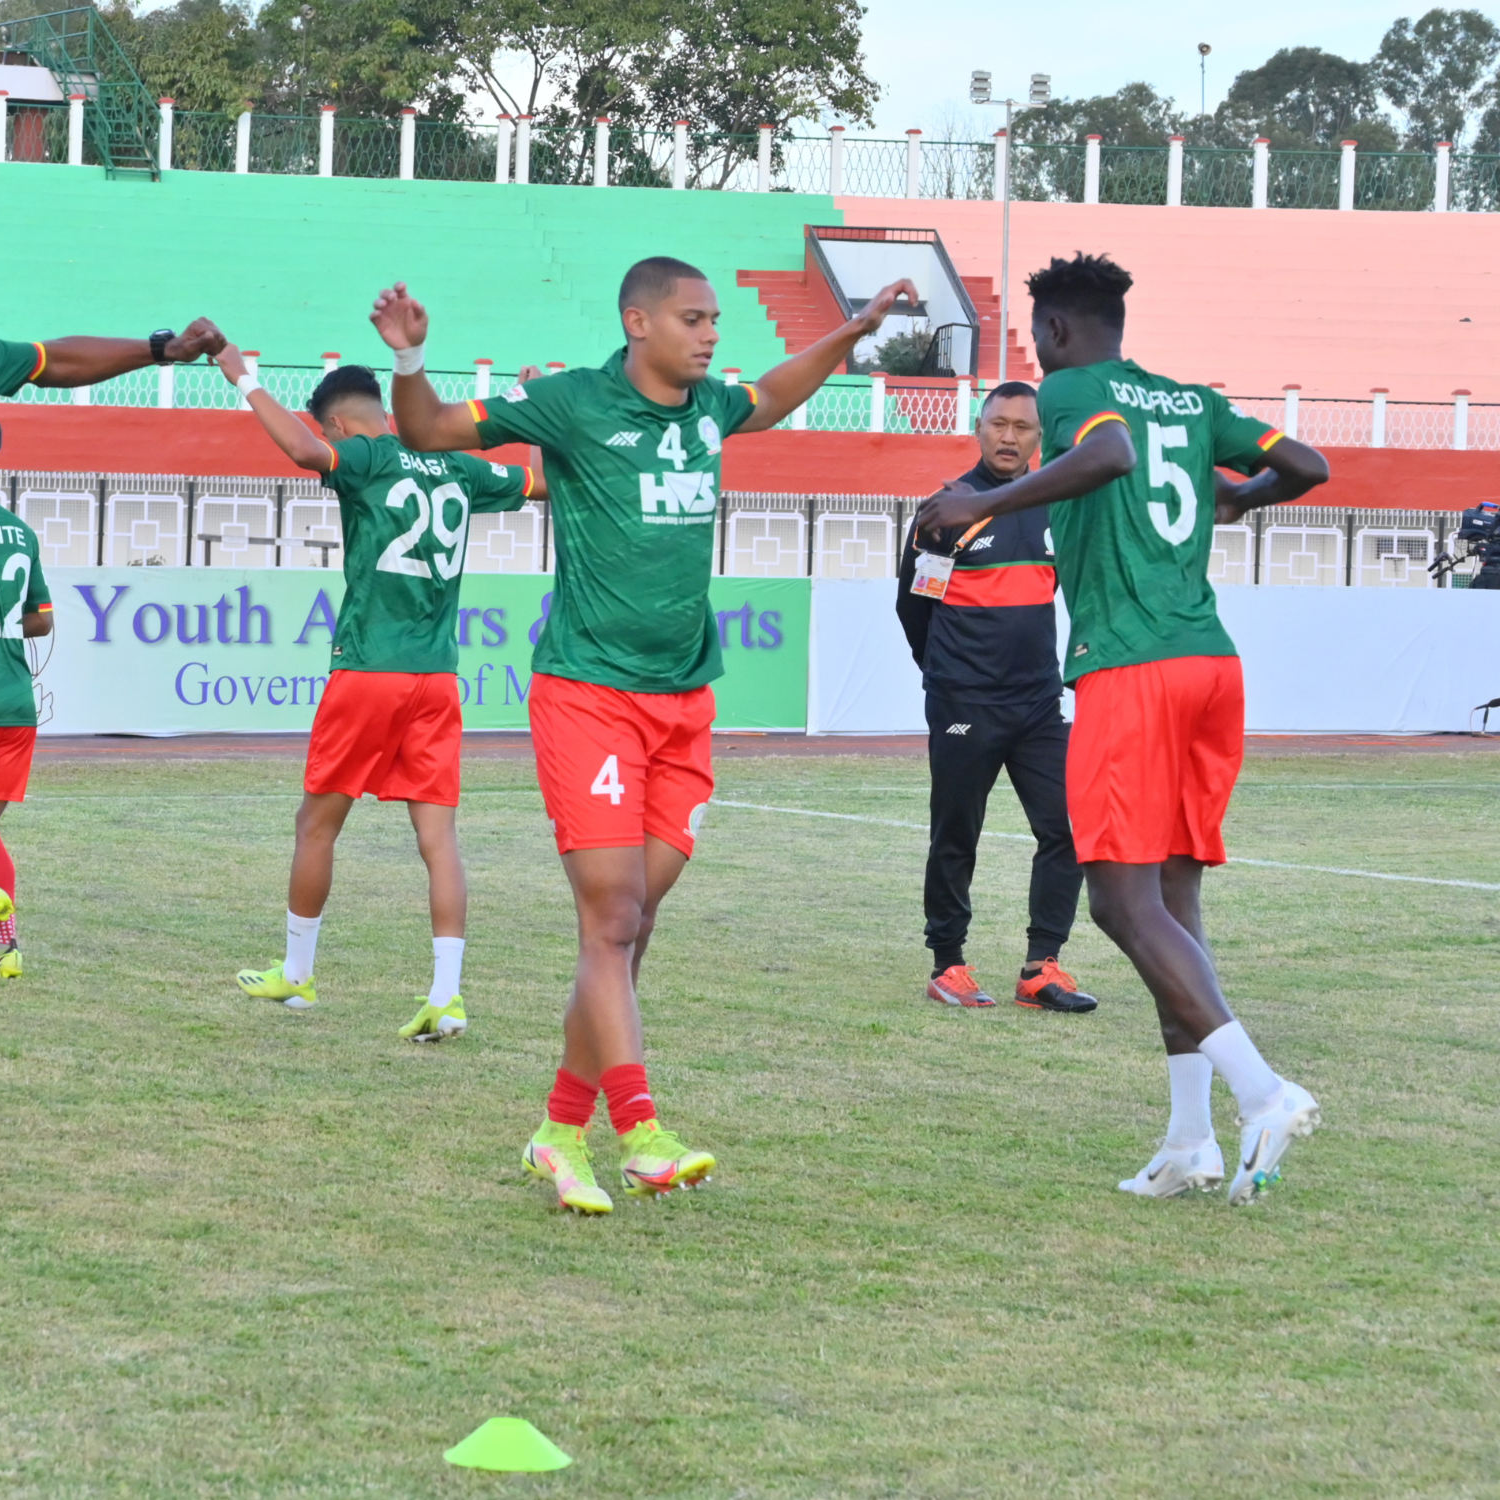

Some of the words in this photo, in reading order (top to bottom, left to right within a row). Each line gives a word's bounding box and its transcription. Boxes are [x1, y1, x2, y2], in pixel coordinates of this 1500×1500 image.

[1109, 379, 1204, 415] GODFRED
[656, 422, 688, 471] 4
[639, 471, 717, 514] HVS
[1146, 421, 1198, 546] 5
[376, 477, 470, 581] 29
[72, 584, 272, 645] Youth
[174, 661, 328, 706] Govern
[590, 754, 625, 805] 4
